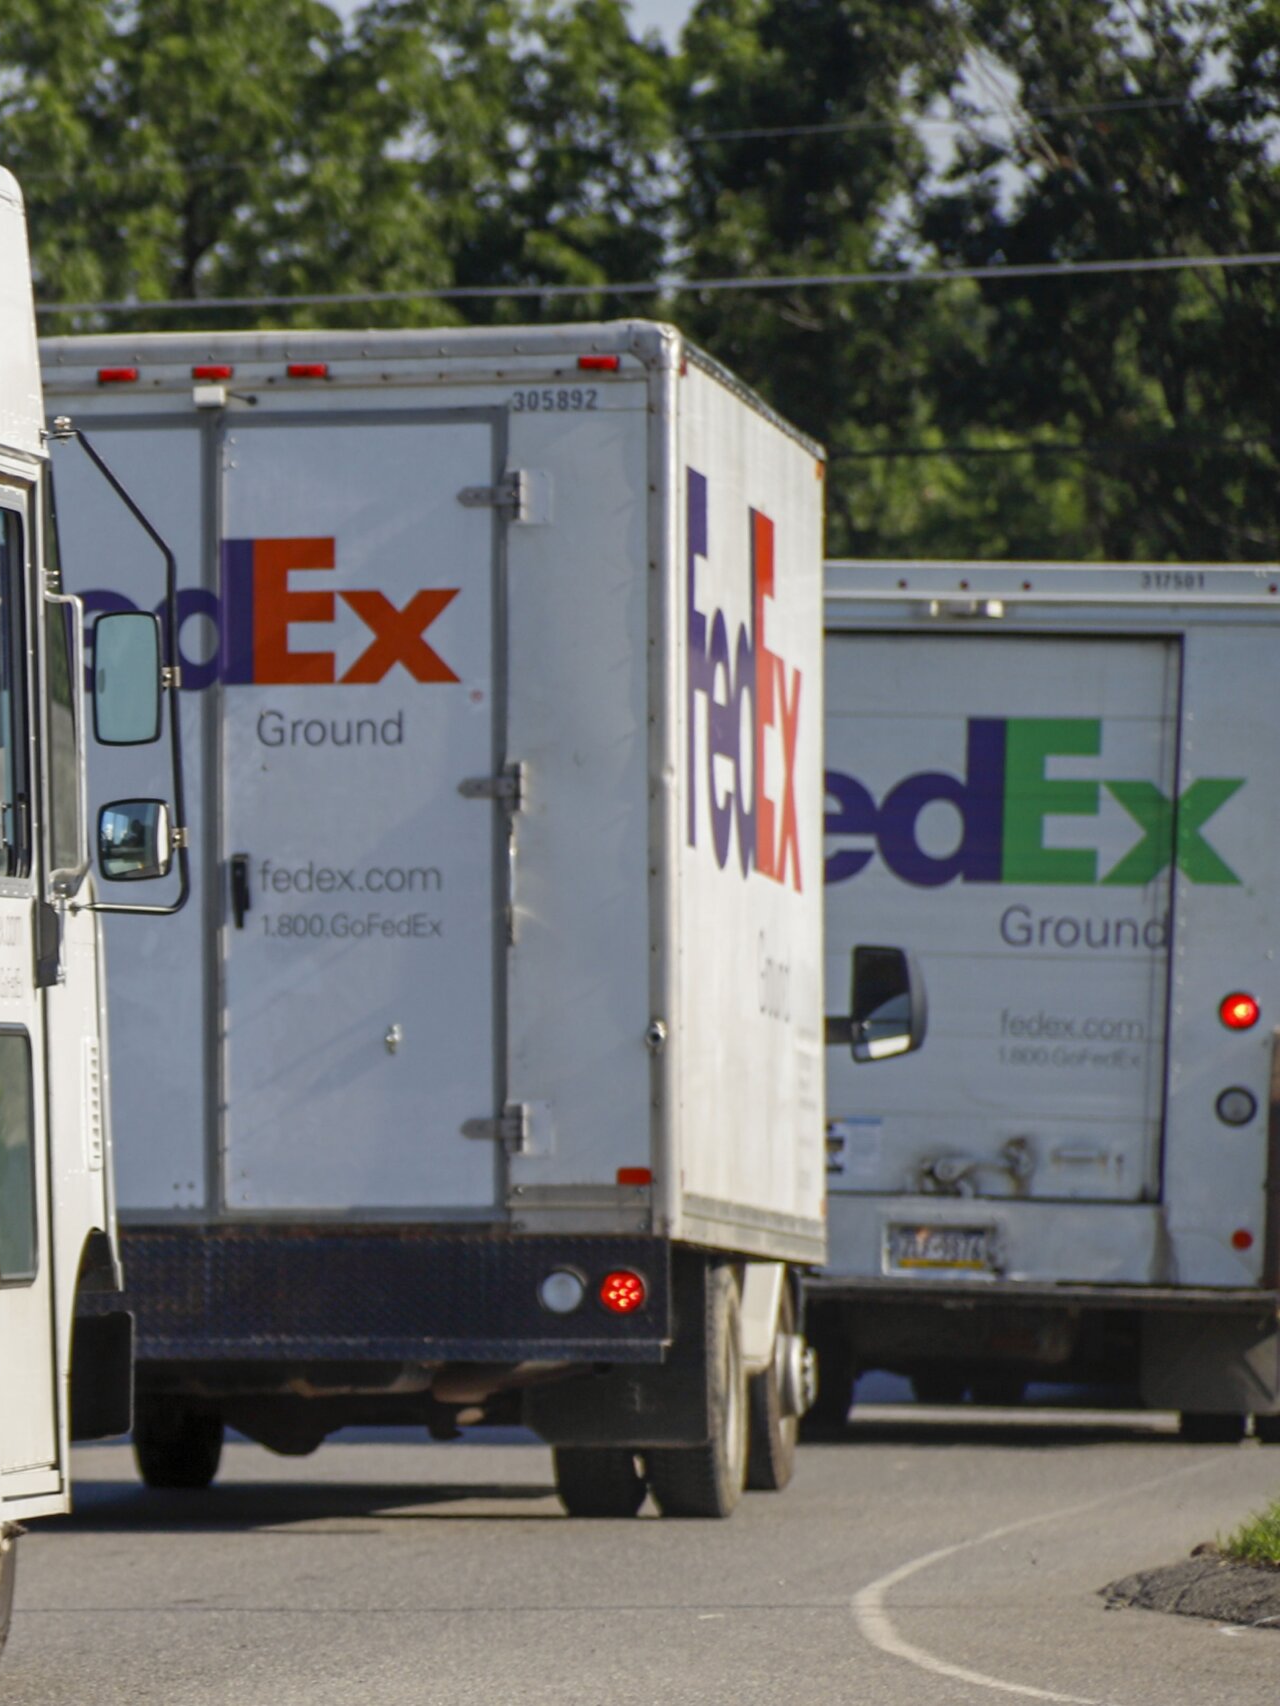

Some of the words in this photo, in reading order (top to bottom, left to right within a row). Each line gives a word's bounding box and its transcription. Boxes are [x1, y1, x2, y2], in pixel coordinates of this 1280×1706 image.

[511, 388, 599, 412] 305892
[686, 466, 803, 894] FedEx
[256, 709, 404, 748] Ground
[259, 860, 442, 893] fedex.com
[261, 912, 443, 938] 1.800.GoFedEx
[999, 904, 1170, 949] Ground
